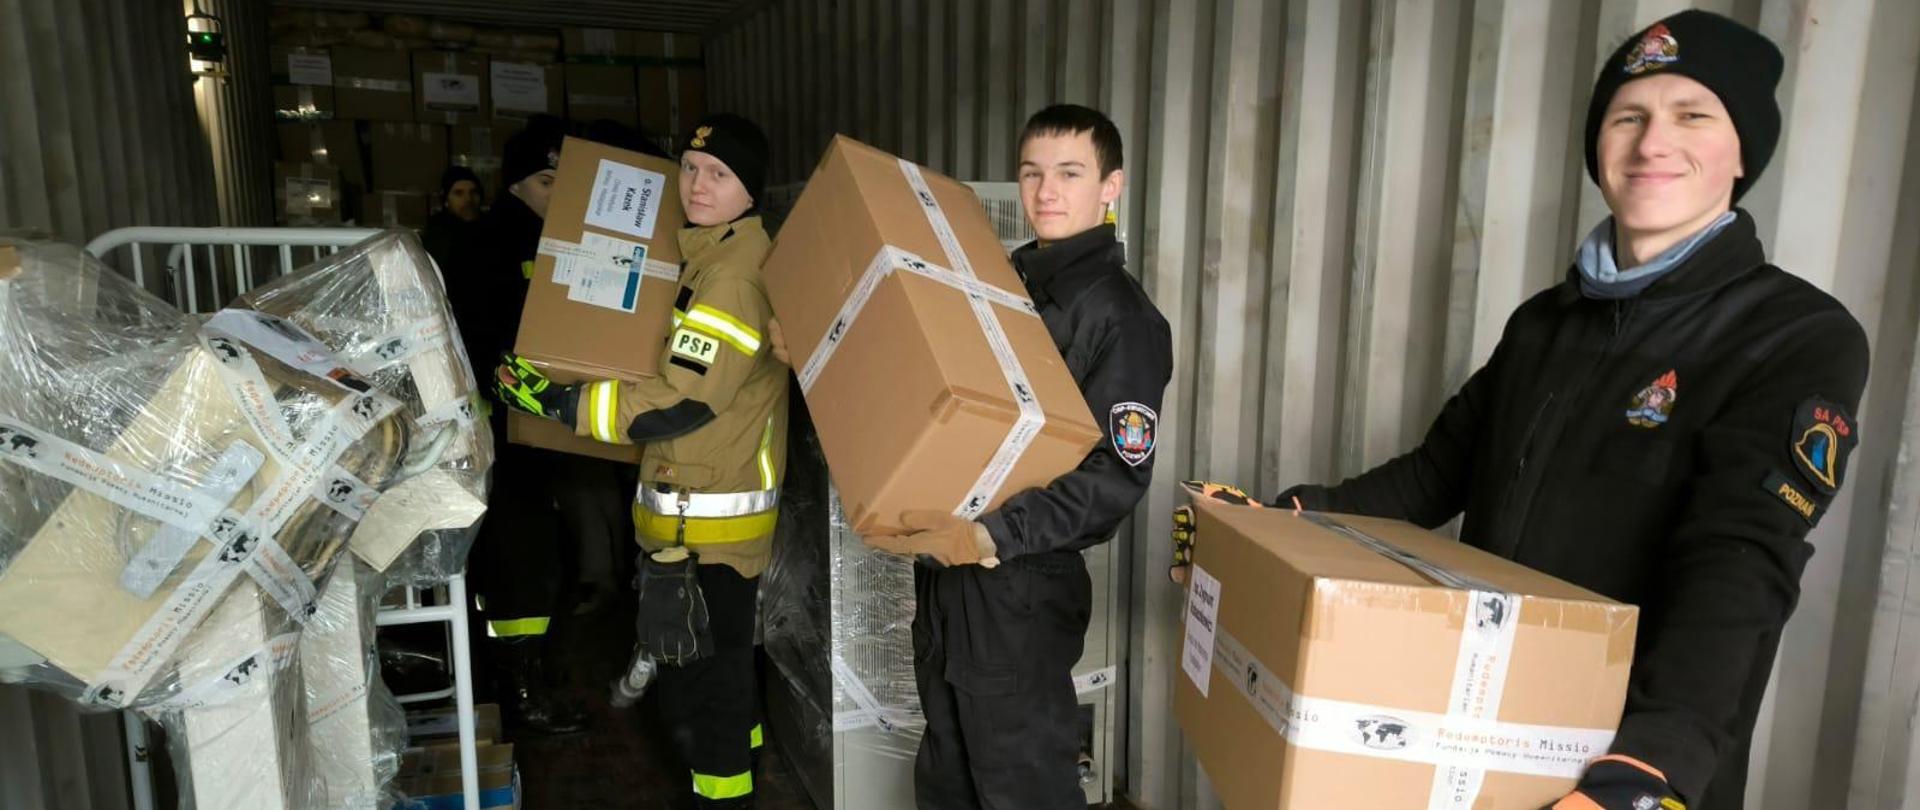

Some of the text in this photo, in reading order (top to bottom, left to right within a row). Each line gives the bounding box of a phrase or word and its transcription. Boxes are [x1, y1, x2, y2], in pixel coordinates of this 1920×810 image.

[678, 334, 713, 357] PSP
[1813, 407, 1851, 438] SA PSP
[147, 485, 194, 510] Missio
[173, 580, 205, 614] Missio
[1436, 726, 1590, 755] Redemptoris Missio
